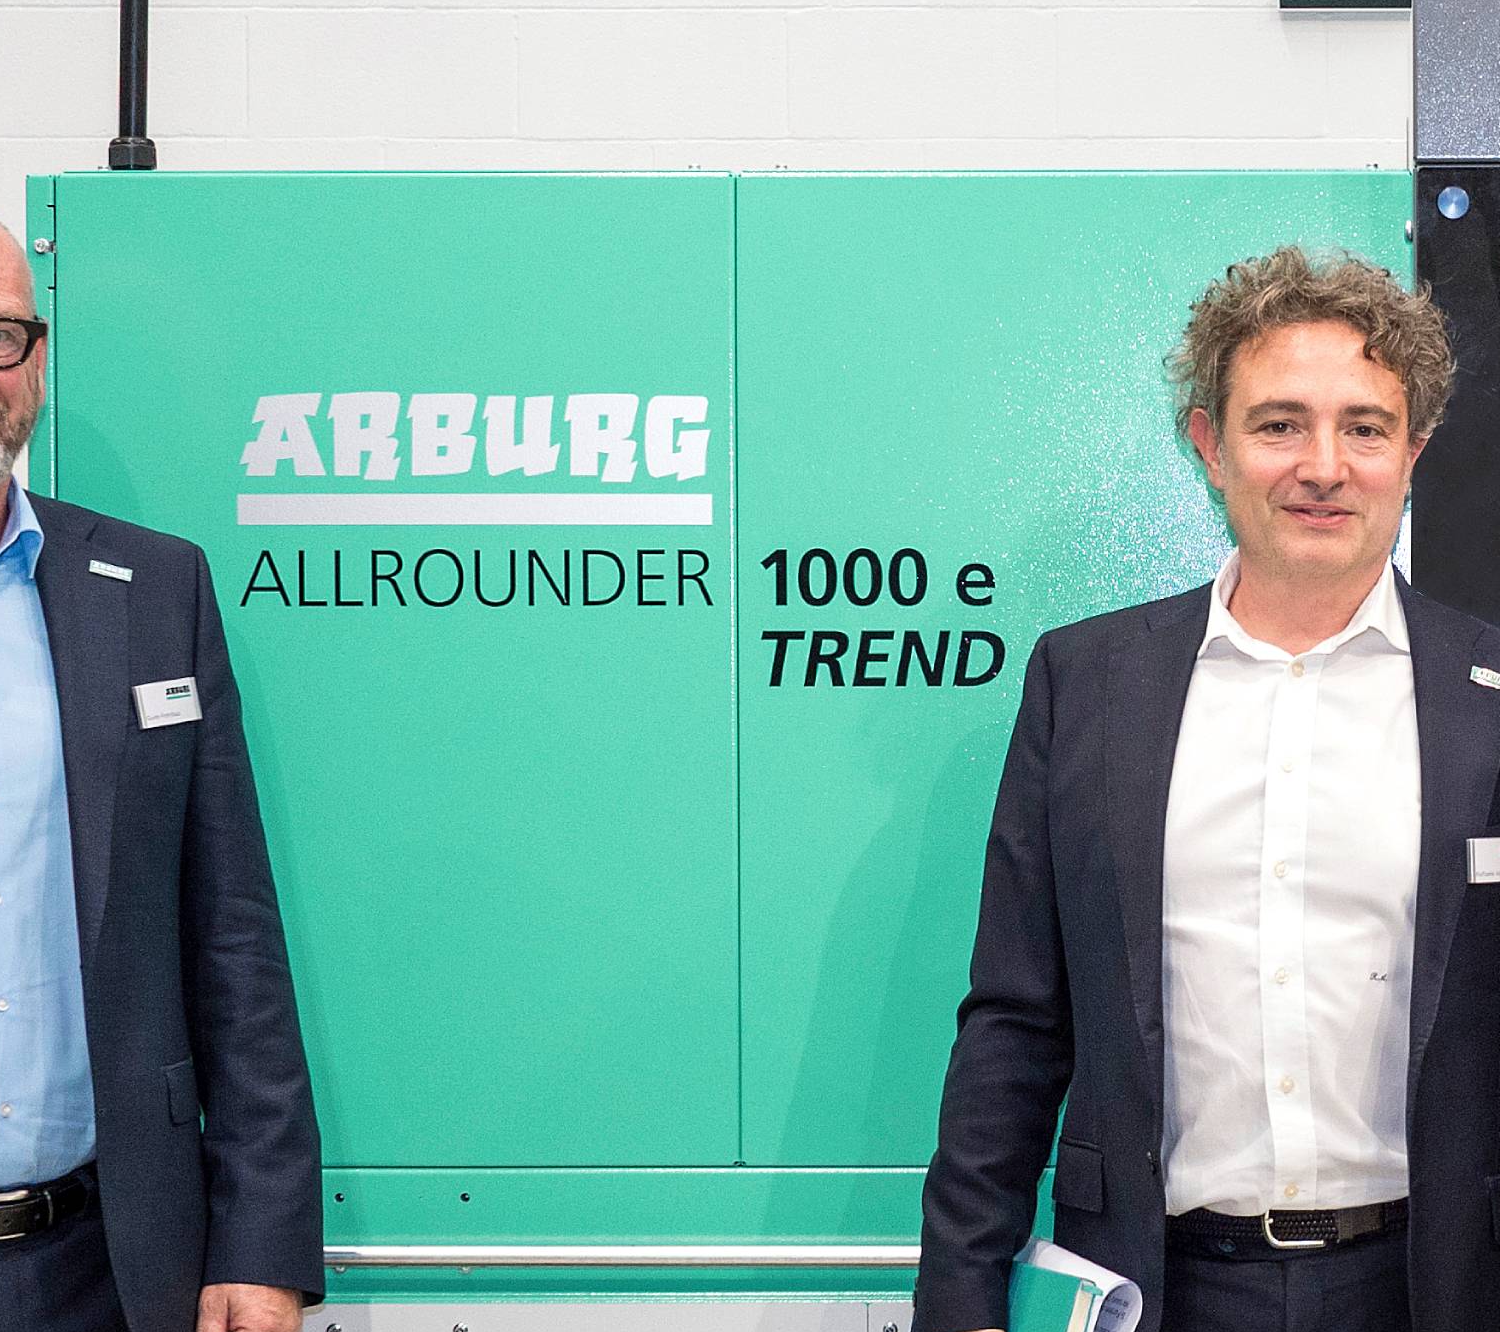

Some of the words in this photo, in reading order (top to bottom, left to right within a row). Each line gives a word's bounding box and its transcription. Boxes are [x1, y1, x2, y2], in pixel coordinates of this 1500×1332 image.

[240, 391, 711, 483] ARBURG
[240, 548, 713, 608] ALLROUNDER
[760, 548, 927, 606] 1000
[955, 563, 996, 607] e
[760, 630, 1005, 688] TREND
